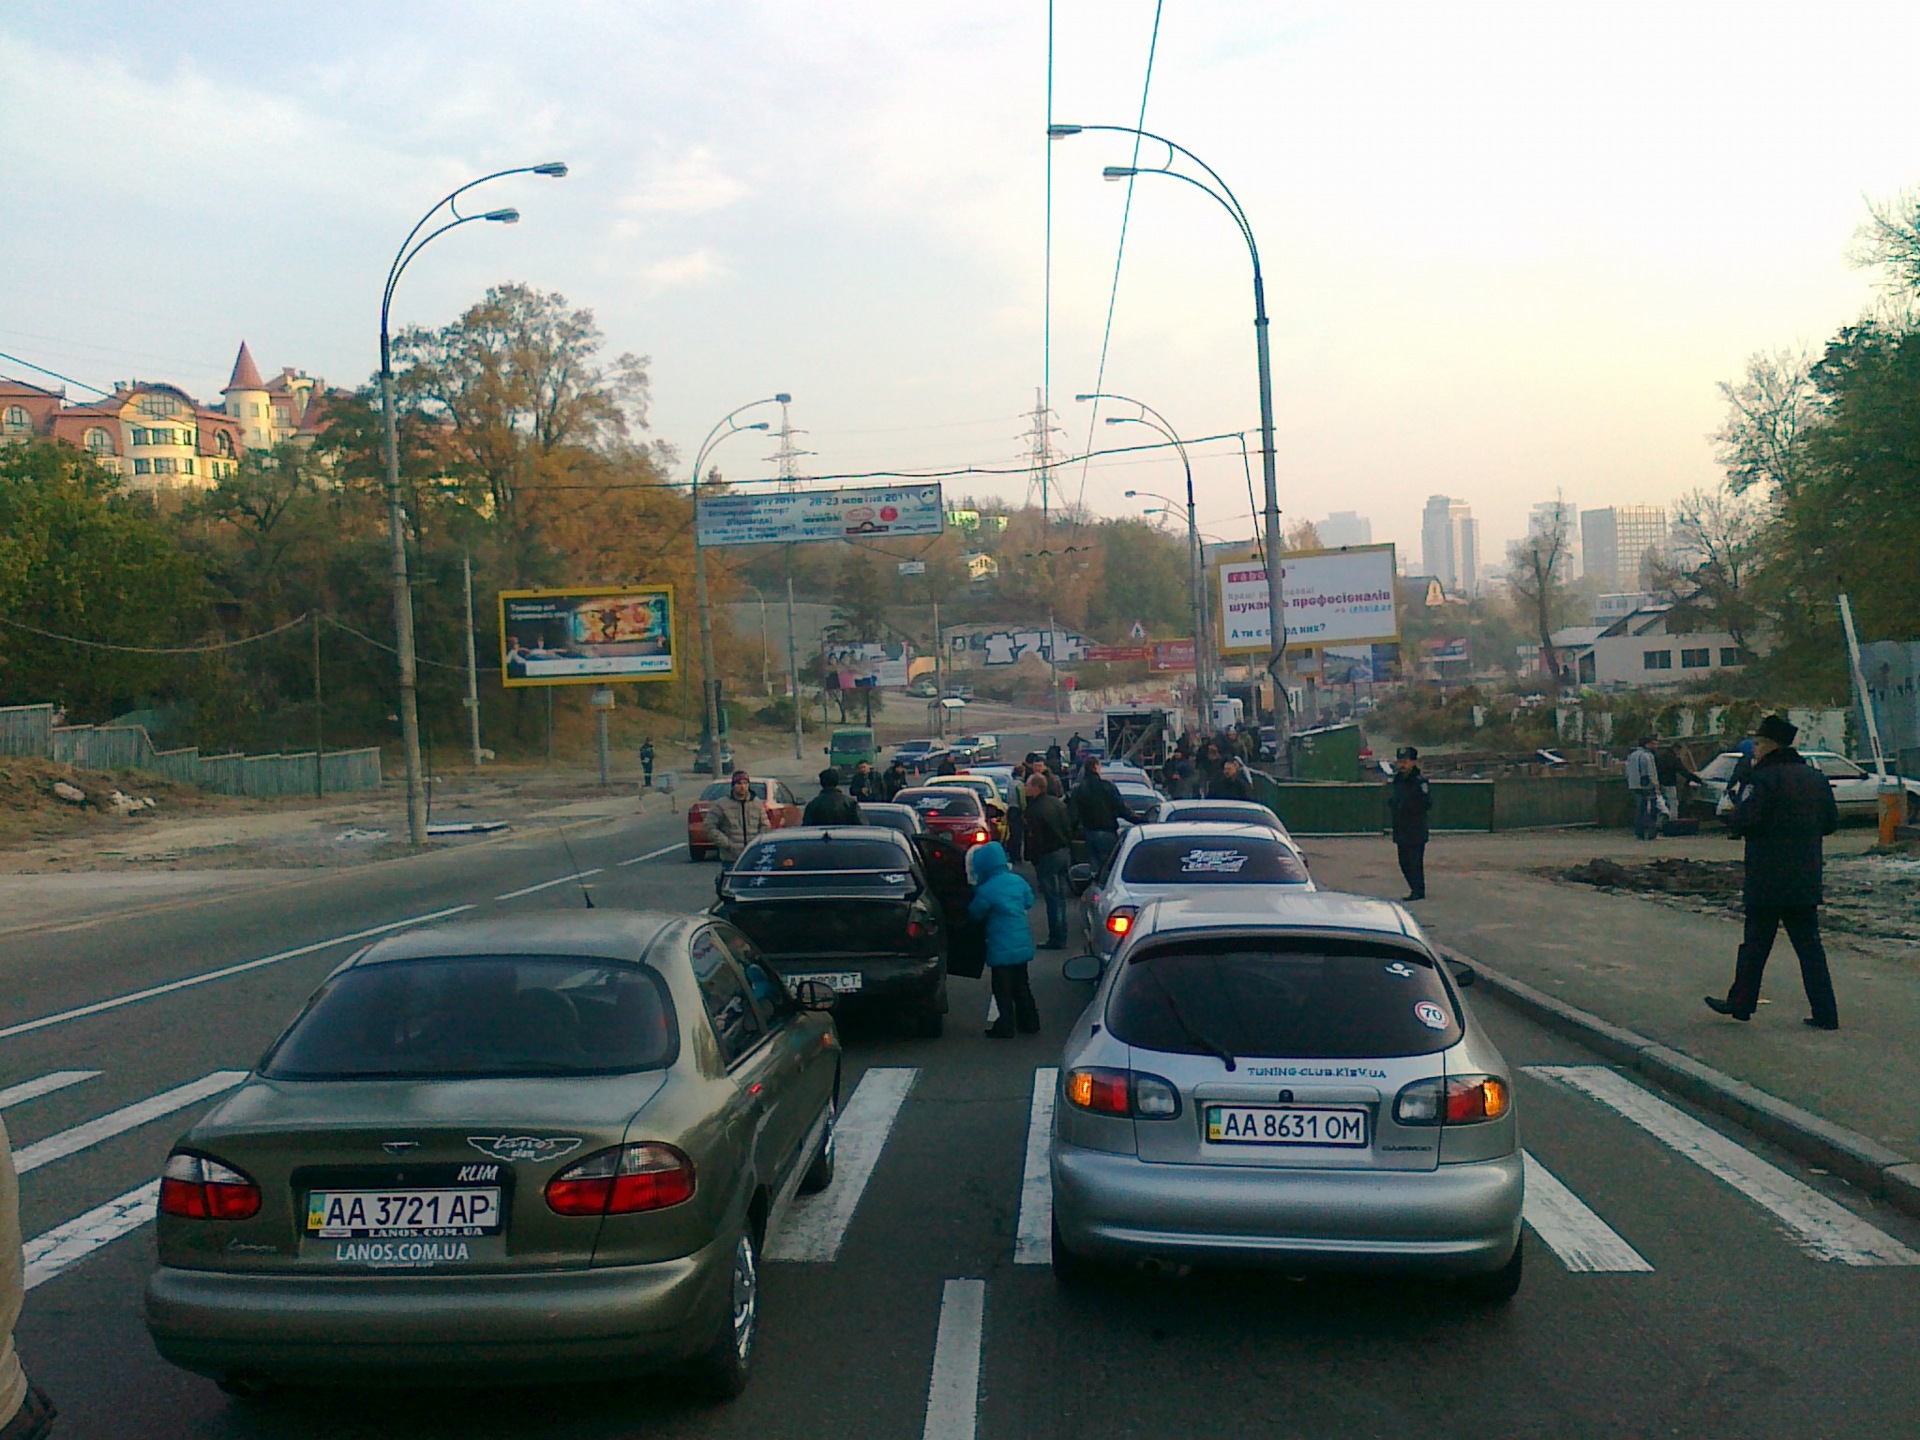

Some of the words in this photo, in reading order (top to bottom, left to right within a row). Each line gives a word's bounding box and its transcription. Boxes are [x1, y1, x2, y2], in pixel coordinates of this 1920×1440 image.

[1292, 590, 1391, 608] професіоналів
[1421, 1007, 1443, 1021] 70
[1225, 1112, 1257, 1138] AA
[1263, 1114, 1318, 1139] 8631
[1325, 1115, 1361, 1141] OM
[457, 1165, 499, 1182] KLIM
[325, 1197, 367, 1226] AA
[375, 1196, 440, 1226] 3721
[448, 1196, 490, 1225] AP
[368, 1226, 484, 1238] LANOS.COM.UA
[335, 1243, 469, 1262] LANOS.COM.UA
